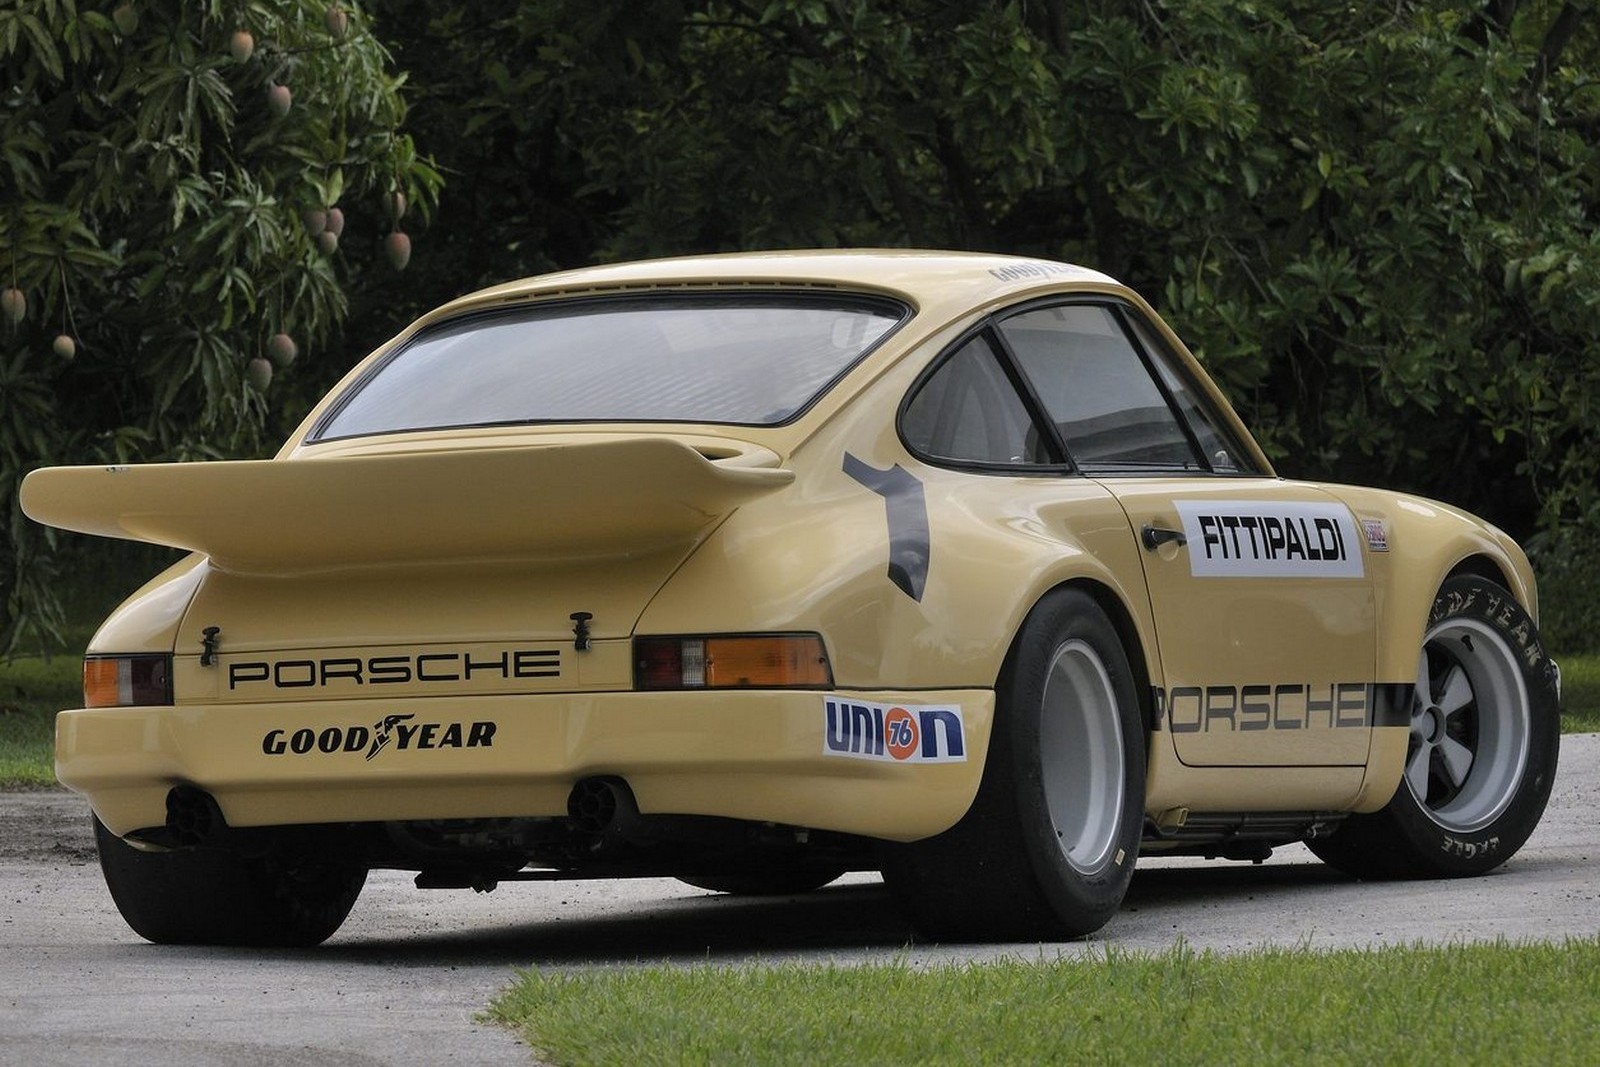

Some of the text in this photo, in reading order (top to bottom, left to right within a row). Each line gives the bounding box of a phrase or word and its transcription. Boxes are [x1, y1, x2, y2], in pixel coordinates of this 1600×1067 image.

[988, 262, 1086, 282] GOODYE
[842, 451, 930, 603] 1
[1198, 515, 1347, 562] FITTIPALDI
[229, 649, 561, 690] PORSCHE
[889, 719, 912, 747] 76
